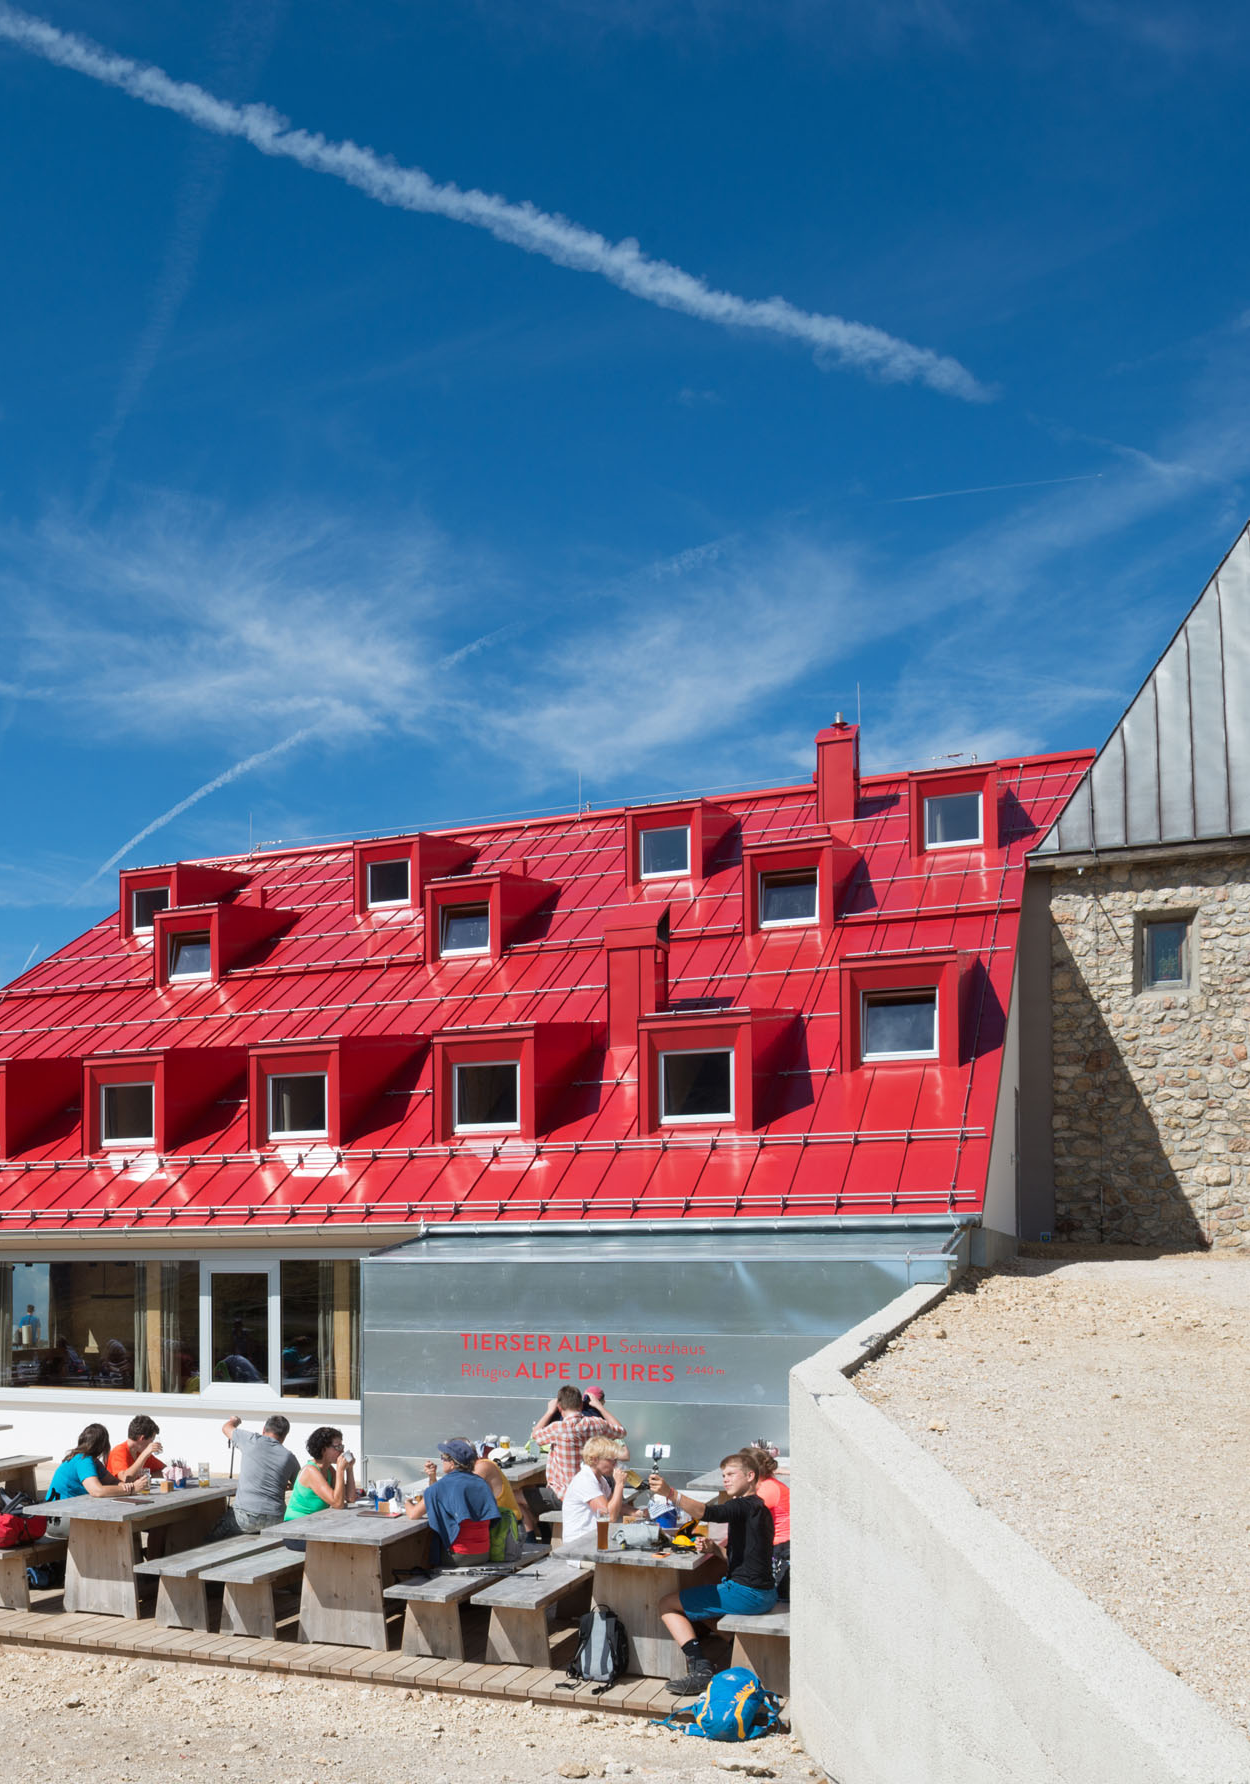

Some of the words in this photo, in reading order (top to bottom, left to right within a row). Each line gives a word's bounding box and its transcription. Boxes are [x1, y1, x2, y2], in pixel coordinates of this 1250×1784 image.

[460, 1333, 552, 1352] TIERSER
[557, 1334, 614, 1353] ALPL
[619, 1338, 706, 1356] Schutzhaus
[461, 1363, 510, 1382] Rifugio
[514, 1361, 571, 1380] ALPE
[578, 1362, 603, 1381] DI
[608, 1362, 675, 1383] TIRES
